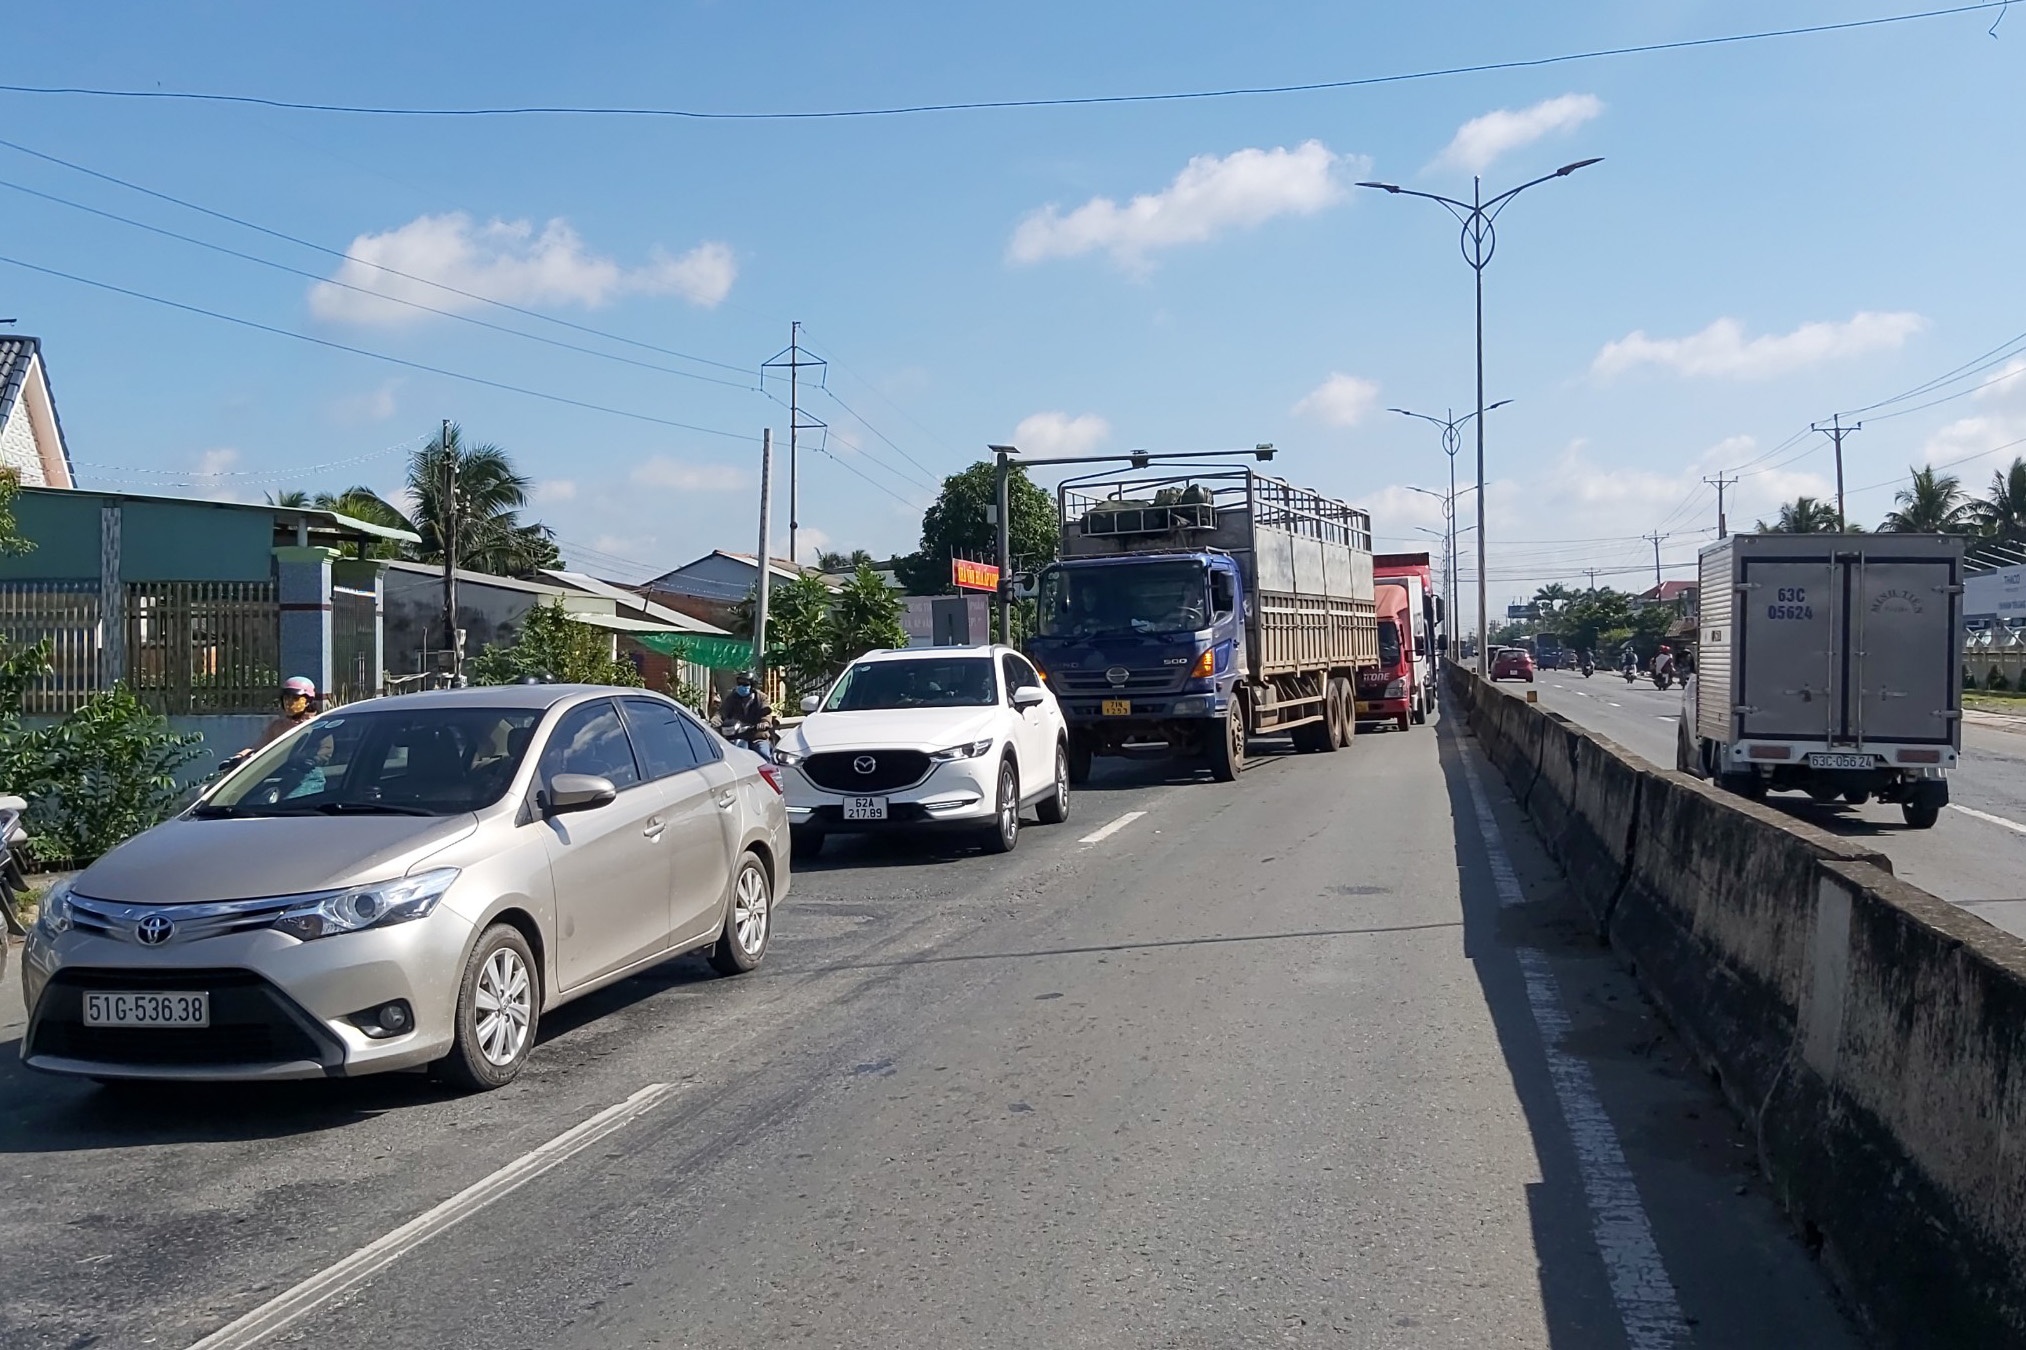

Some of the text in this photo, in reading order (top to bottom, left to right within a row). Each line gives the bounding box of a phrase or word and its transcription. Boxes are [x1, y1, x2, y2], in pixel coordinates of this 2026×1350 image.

[1777, 587, 1806, 603] 63C
[1767, 605, 1814, 620] 05624
[855, 798, 874, 807] 62A
[848, 808, 882, 818] 217.89
[88, 995, 203, 1022] 51G-536.38
